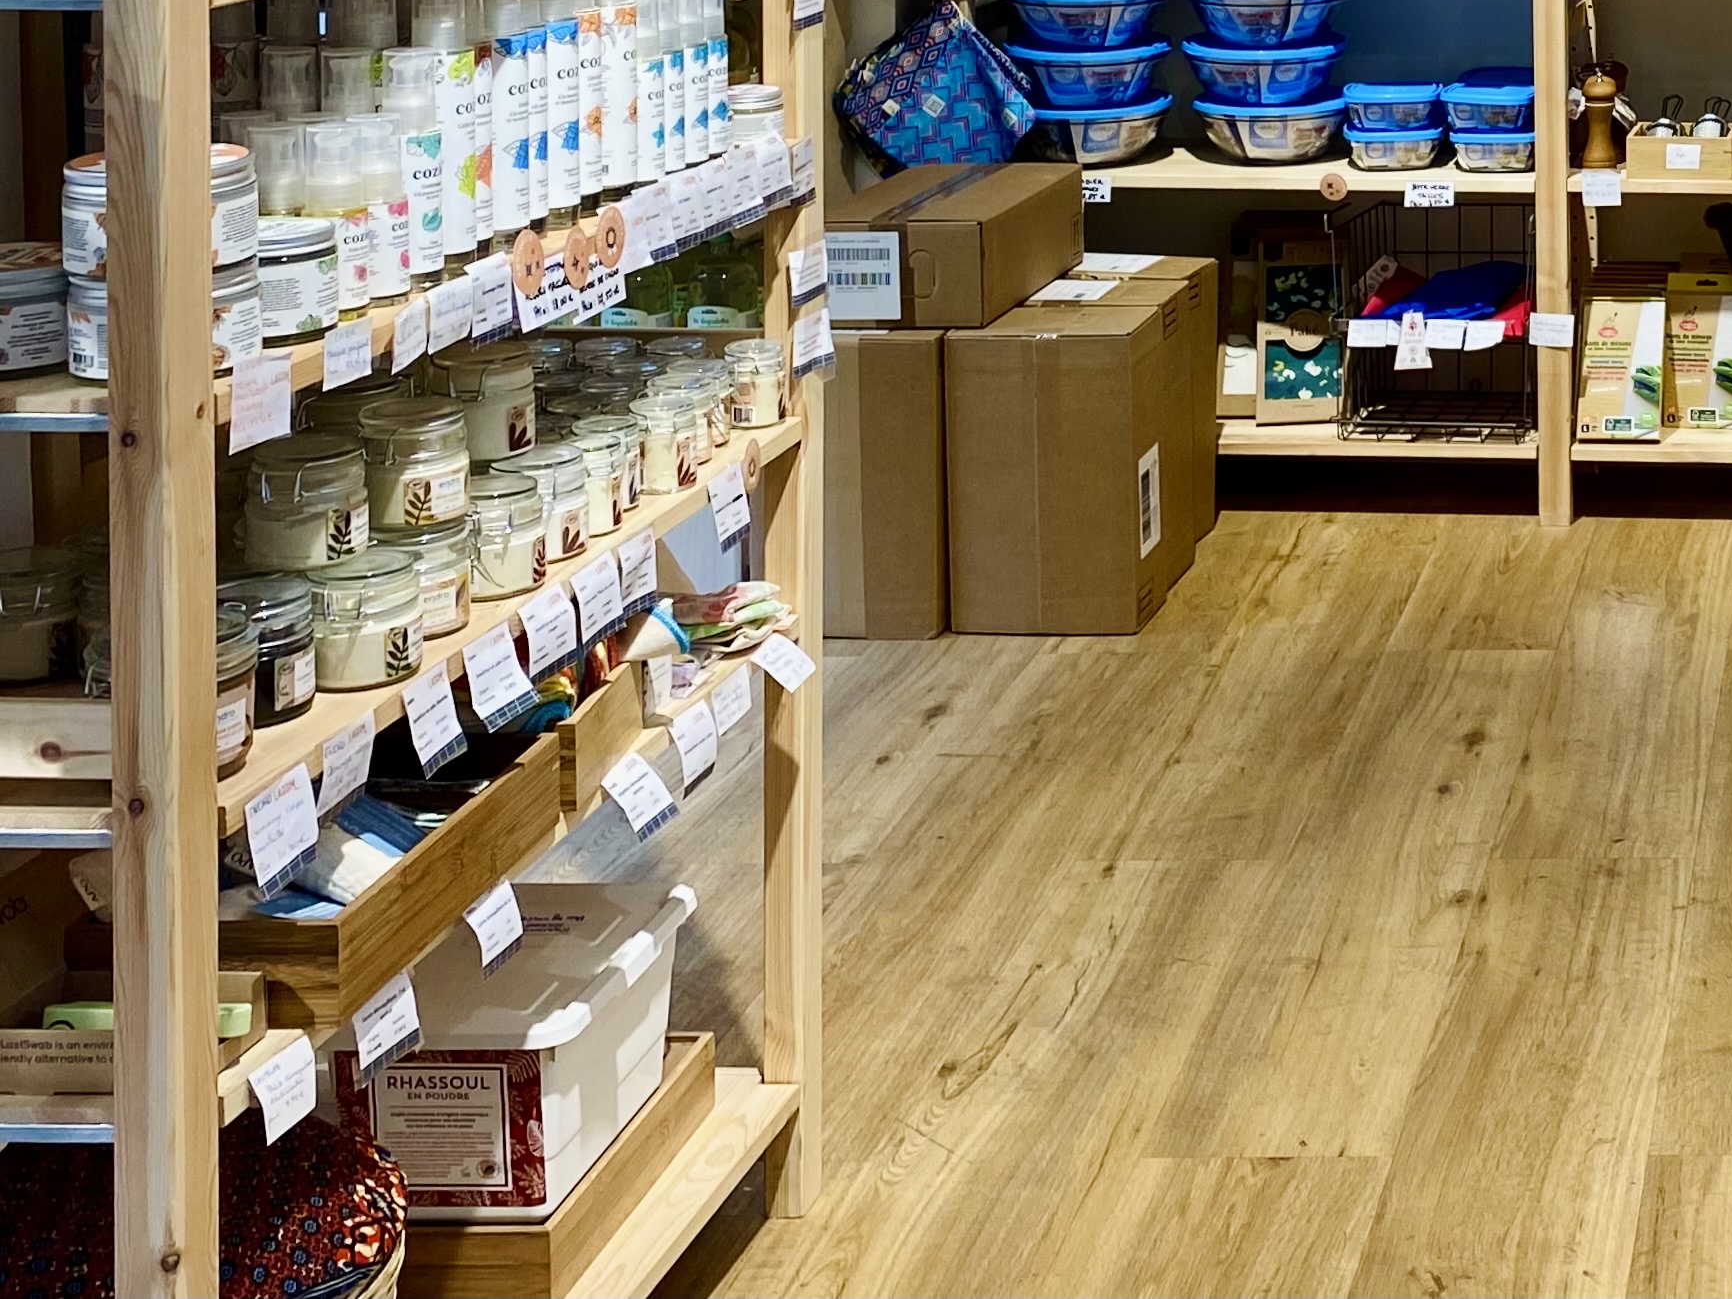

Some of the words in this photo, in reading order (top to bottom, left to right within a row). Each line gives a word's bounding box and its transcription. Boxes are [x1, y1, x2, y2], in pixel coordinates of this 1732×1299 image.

[424, 591, 450, 604] endro
[0, 1040, 52, 1050] LastSwab
[55, 1040, 64, 1050] is
[66, 1043, 81, 1051] an
[35, 1053, 93, 1063] alternative
[96, 1054, 107, 1063] to
[386, 1076, 491, 1090] RHASSOUL
[407, 1092, 422, 1100] EN
[425, 1092, 470, 1100] POUDRE
